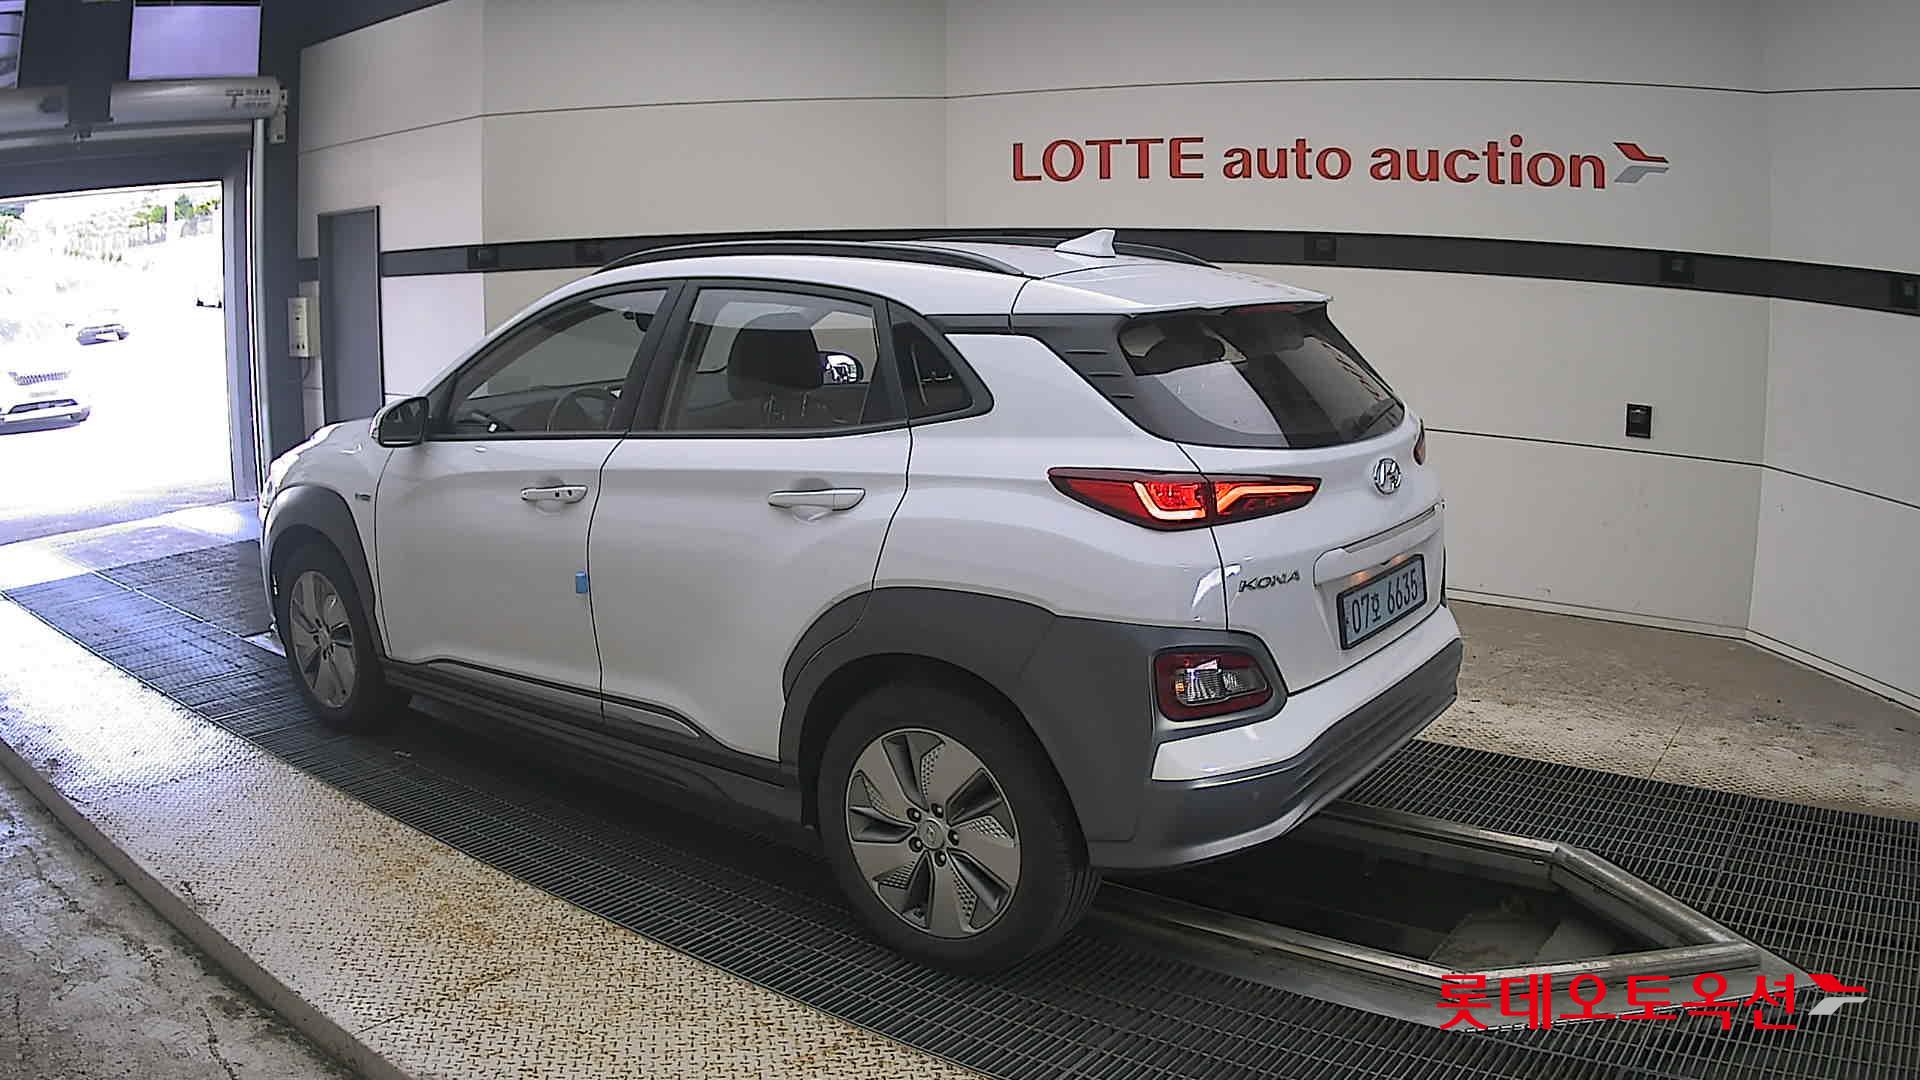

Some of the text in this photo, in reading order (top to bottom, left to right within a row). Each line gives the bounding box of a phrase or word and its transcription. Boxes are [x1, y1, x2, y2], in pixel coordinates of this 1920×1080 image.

[1012, 134, 1606, 189] LOTTE auto auction
[1238, 570, 1300, 593] KONA
[1387, 567, 1419, 615] 6635
